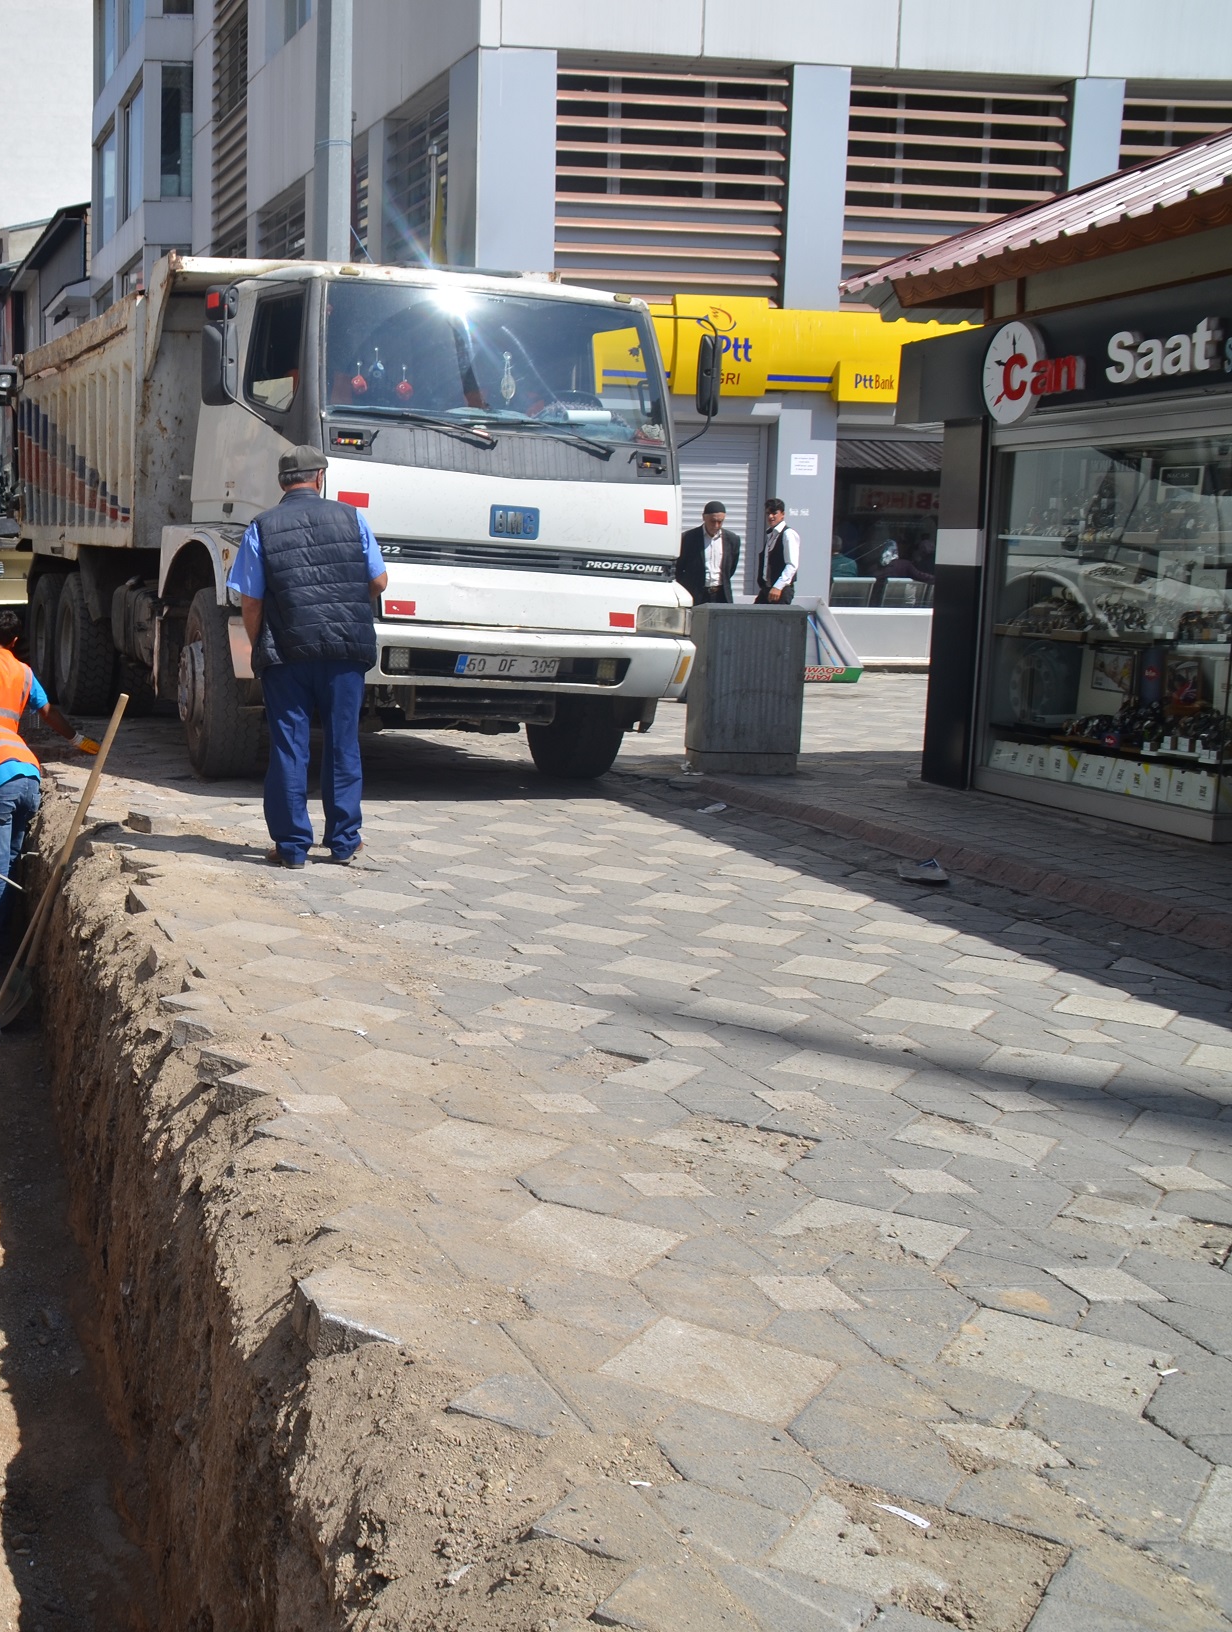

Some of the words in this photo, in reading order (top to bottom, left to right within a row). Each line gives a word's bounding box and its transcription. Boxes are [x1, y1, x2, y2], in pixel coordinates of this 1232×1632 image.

[718, 335, 752, 362] Ptt
[1002, 352, 1077, 401] Can
[1106, 317, 1213, 384] Saat
[719, 370, 741, 386] RI
[494, 510, 534, 535] BMC
[585, 561, 664, 573] PROFESYONEL
[498, 658, 518, 673] DF
